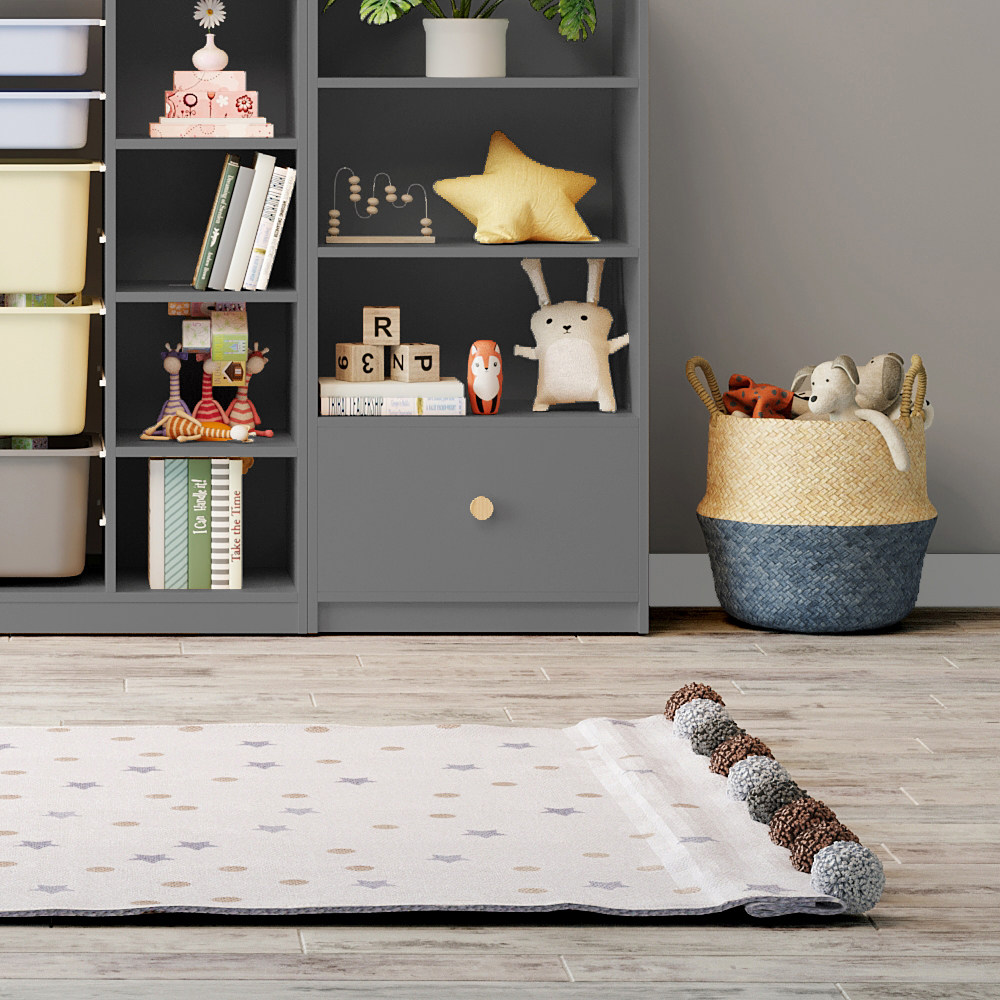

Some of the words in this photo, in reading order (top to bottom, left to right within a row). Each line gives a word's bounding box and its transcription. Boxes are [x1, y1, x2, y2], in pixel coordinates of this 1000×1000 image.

[374, 317, 392, 337] R
[393, 354, 404, 371] N
[414, 355, 432, 371] P
[231, 490, 241, 516] Time
[231, 520, 241, 535] the
[231, 538, 240, 562] Take
